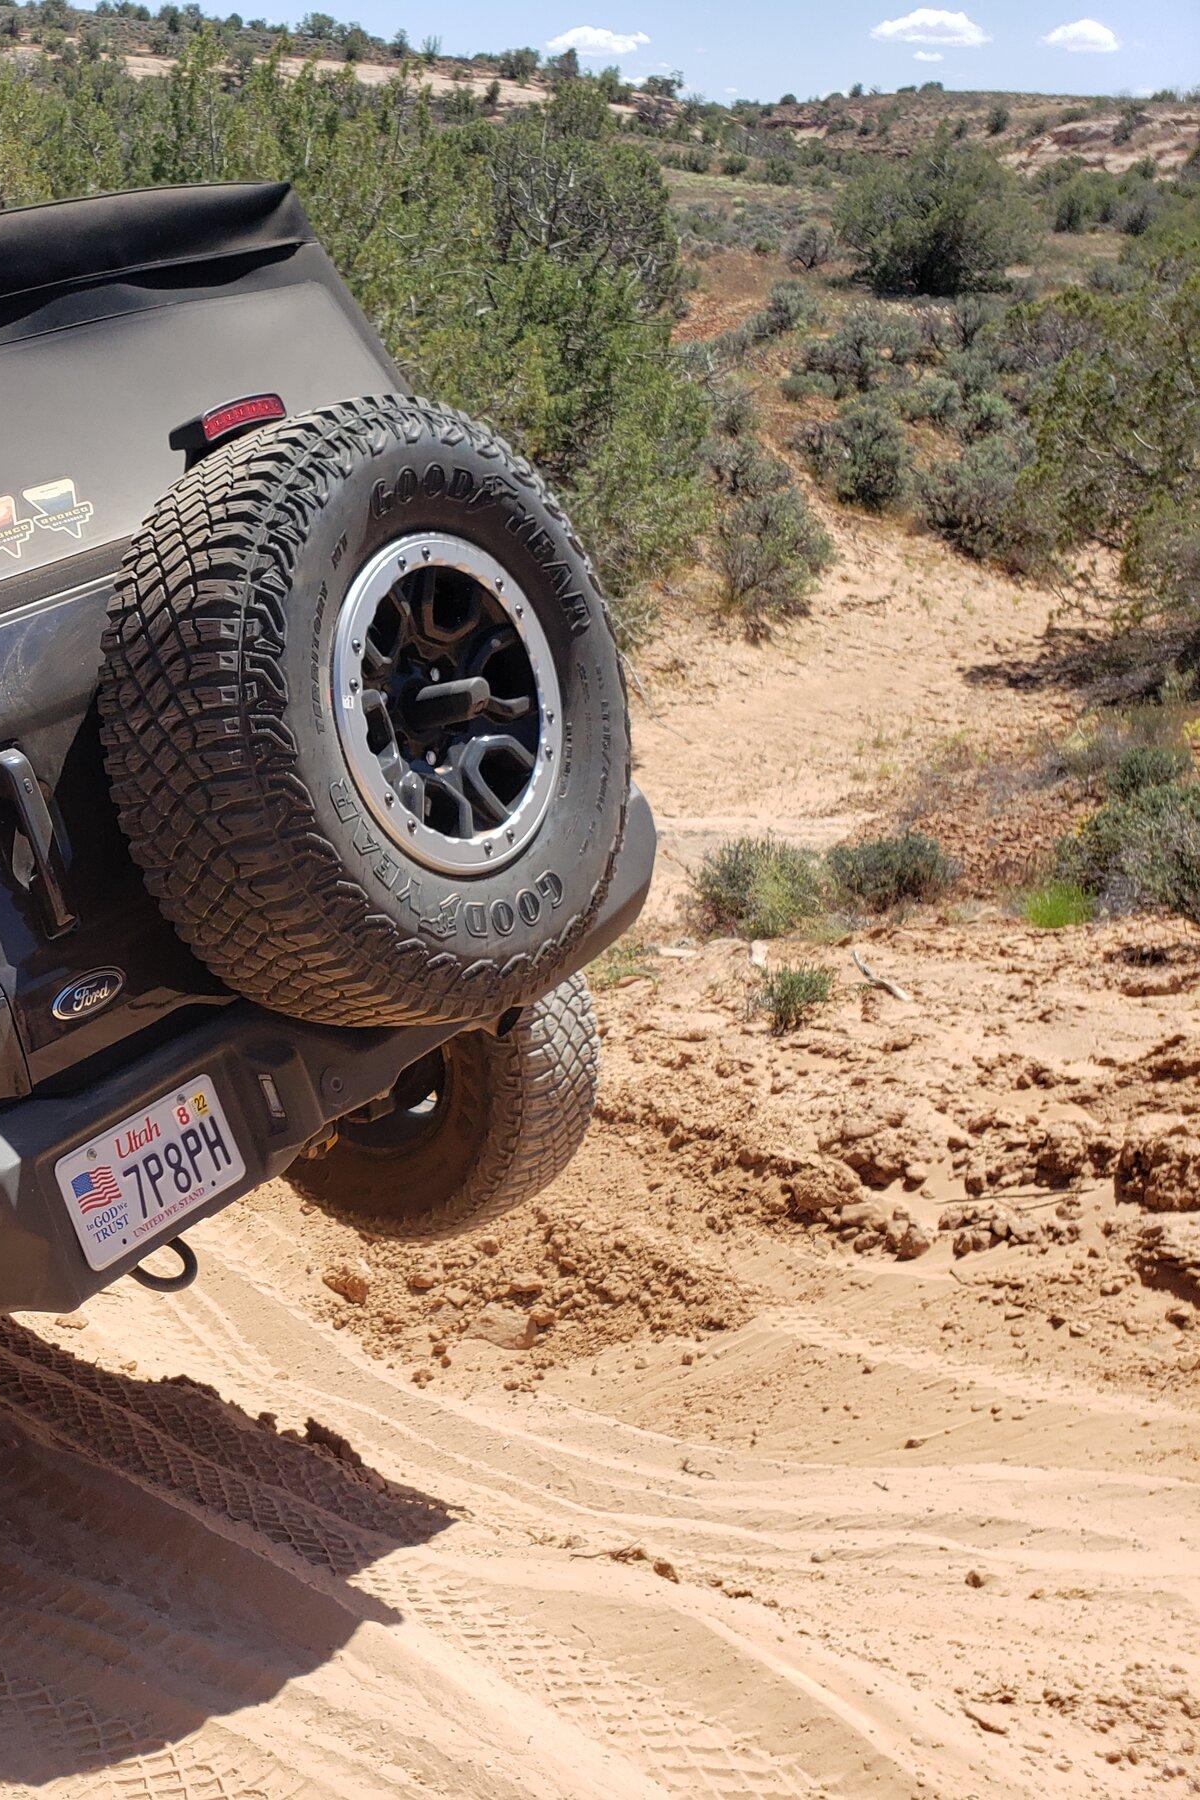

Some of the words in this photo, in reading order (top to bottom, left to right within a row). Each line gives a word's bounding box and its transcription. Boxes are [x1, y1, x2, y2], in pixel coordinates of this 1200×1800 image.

[40, 506, 89, 525] BRONCO
[72, 980, 111, 1012] Ford
[177, 1106, 190, 1125] 8
[194, 1094, 207, 1111] 22
[114, 1117, 161, 1159] Utah
[122, 1115, 231, 1219] 7P8PH
[93, 1213, 129, 1243] TRUST
[94, 1206, 118, 1228] GOD
[133, 1213, 164, 1238] UNITED
[164, 1204, 179, 1217] WE
[178, 1187, 205, 1209] STAND
